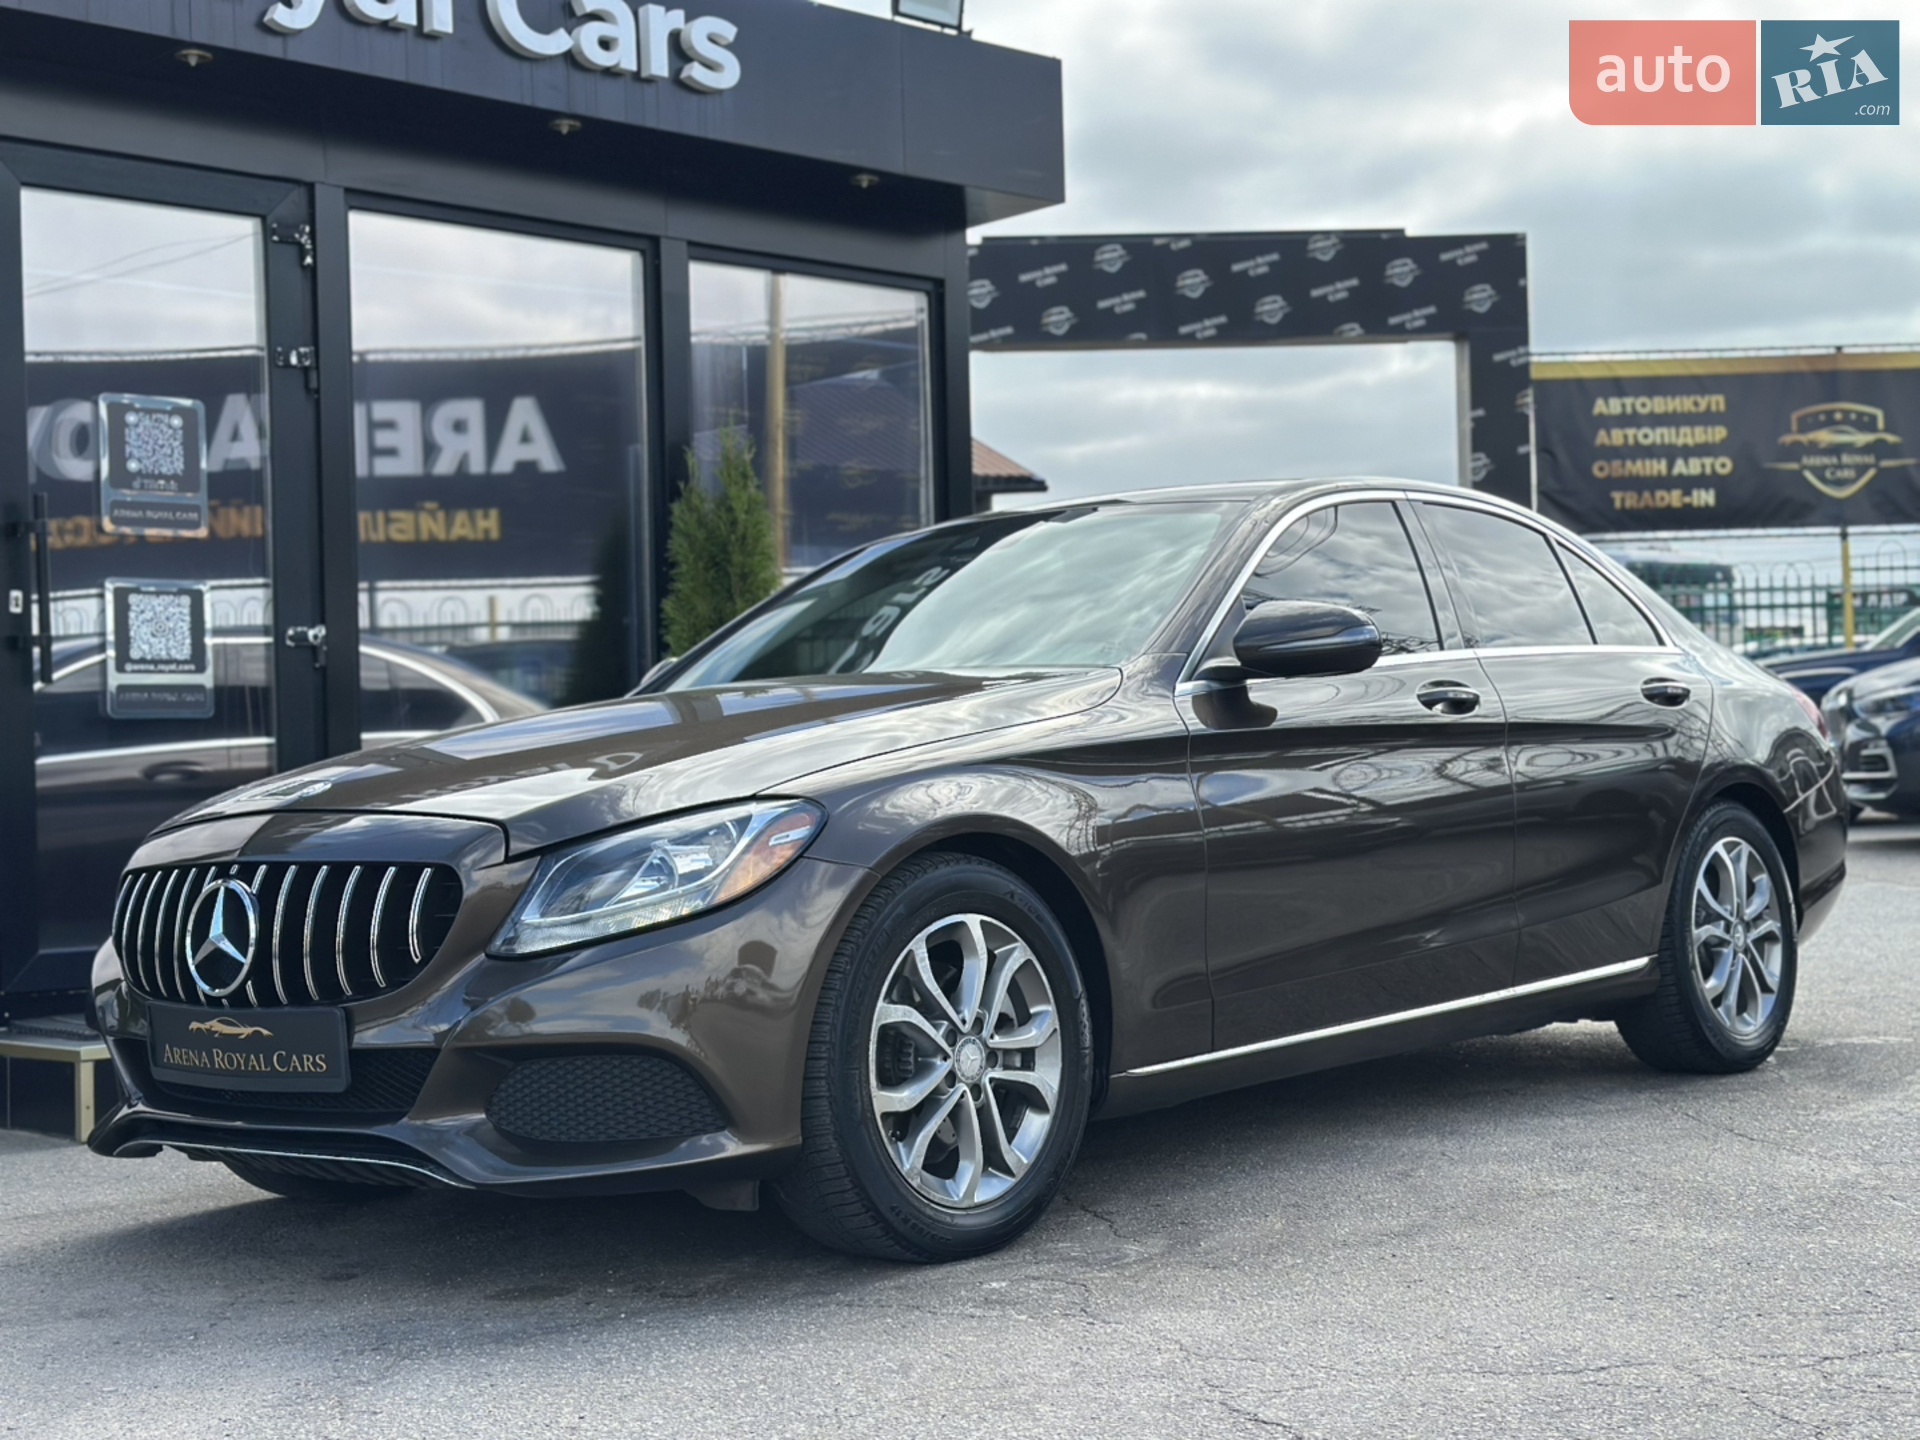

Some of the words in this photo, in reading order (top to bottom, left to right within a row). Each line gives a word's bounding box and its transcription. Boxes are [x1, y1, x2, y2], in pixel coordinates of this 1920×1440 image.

[1592, 394, 1726, 416] АВТОВИКУП
[1594, 425, 1729, 447] АВТОПІДБІР
[1591, 457, 1667, 478] ОБМІН
[1671, 456, 1733, 477] АВТО
[1610, 488, 1716, 510] TRADE-IN
[163, 1043, 210, 1068] ARENA
[213, 1047, 271, 1072] ROYAL
[272, 1050, 328, 1073] CARS
